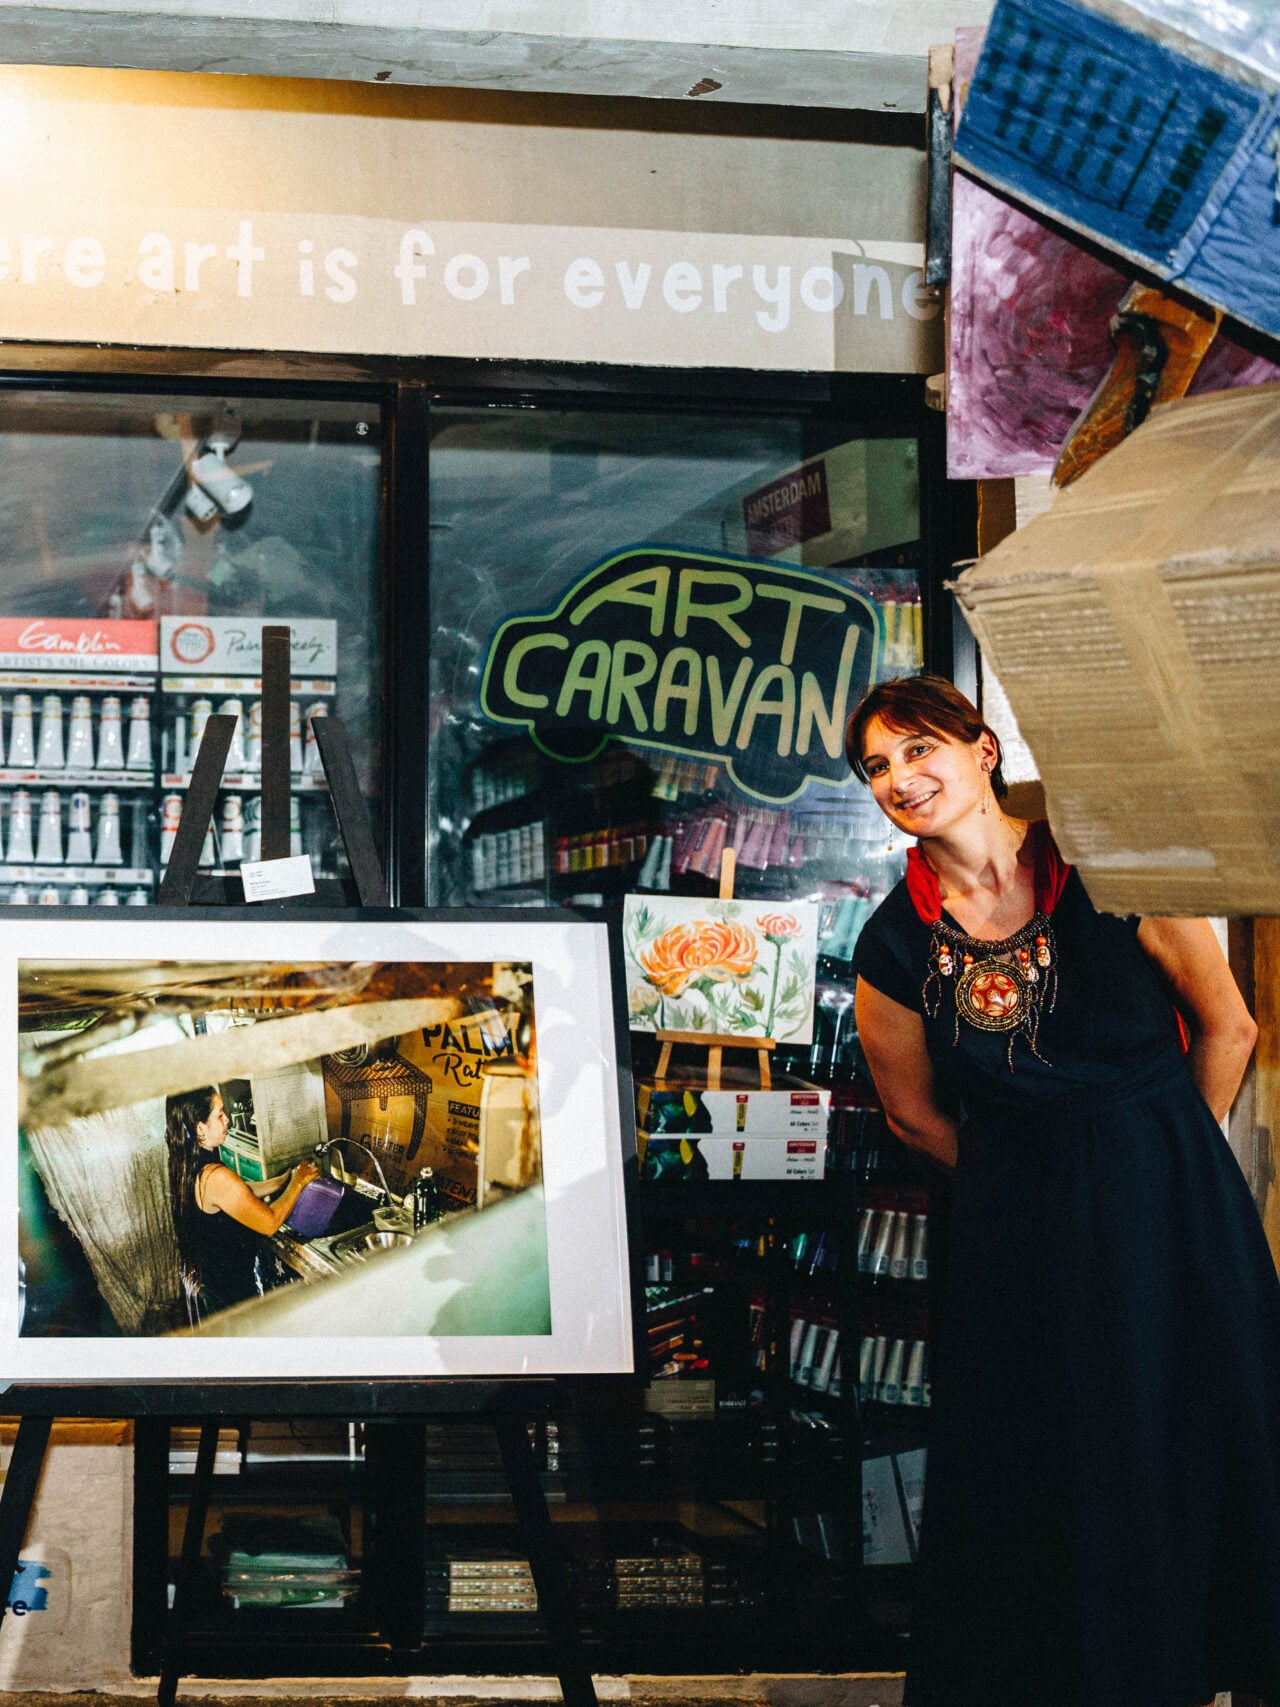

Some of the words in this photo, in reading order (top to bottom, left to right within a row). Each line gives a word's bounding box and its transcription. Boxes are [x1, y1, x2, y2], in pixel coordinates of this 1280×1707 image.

[137, 219, 266, 297] art
[298, 239, 359, 304] is
[394, 228, 530, 305] for
[564, 257, 941, 333] everyone
[747, 471, 822, 524] AMSTERDAM
[569, 566, 847, 665] ART
[17, 620, 122, 653] Gamblin
[224, 629, 263, 656] Pain
[59, 656, 87, 667] OIL
[503, 624, 861, 759] CARAVAN
[432, 1053, 488, 1087] Rat
[449, 1102, 482, 1120] FEATU
[372, 1135, 404, 1157] SETER
